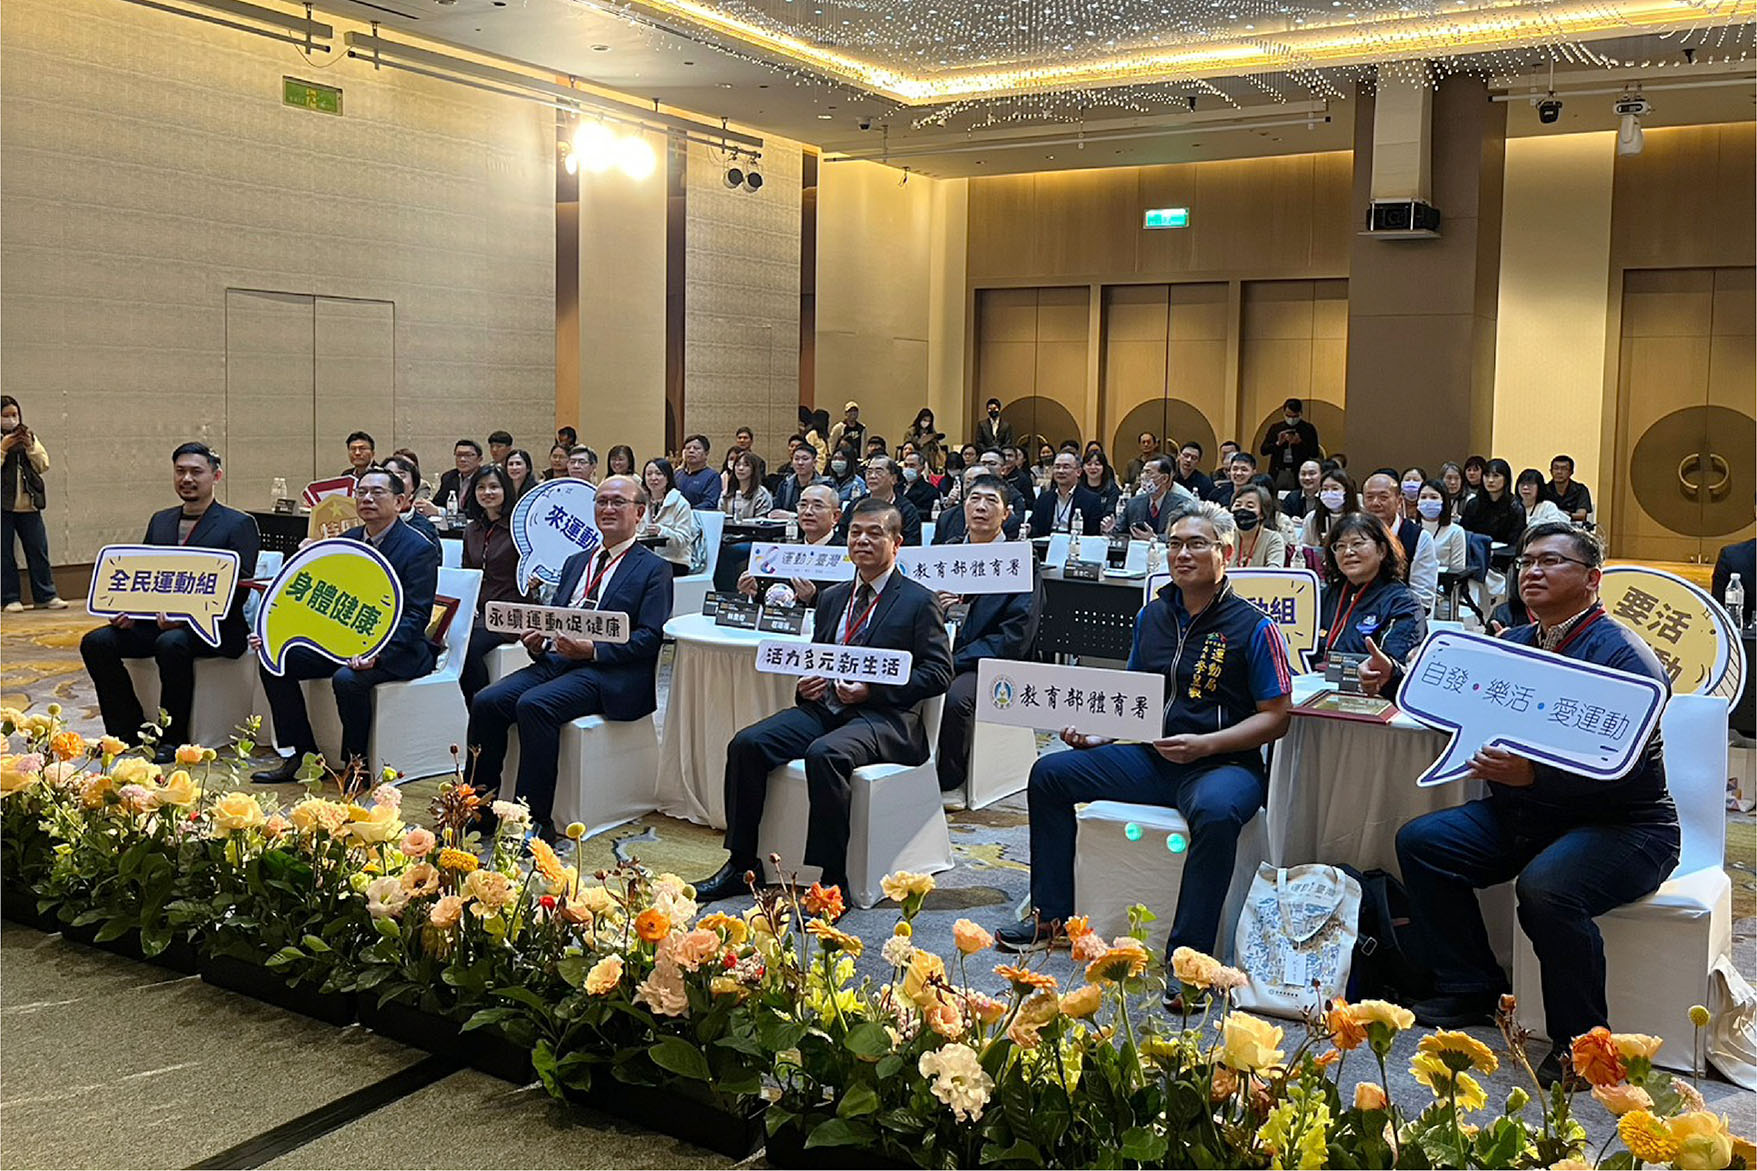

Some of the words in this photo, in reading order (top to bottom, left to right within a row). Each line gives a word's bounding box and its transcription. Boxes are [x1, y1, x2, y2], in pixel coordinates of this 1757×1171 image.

[545, 504, 598, 549] 來運動
[108, 569, 218, 595] 全民運動組
[912, 558, 1021, 580] 教育部體育署
[286, 571, 382, 636] 身體健康
[1613, 585, 1692, 644] 要活
[489, 607, 621, 637] 永續運動促健康
[766, 648, 901, 677] 活力多元新生活
[1019, 683, 1150, 720] 教育部體育署
